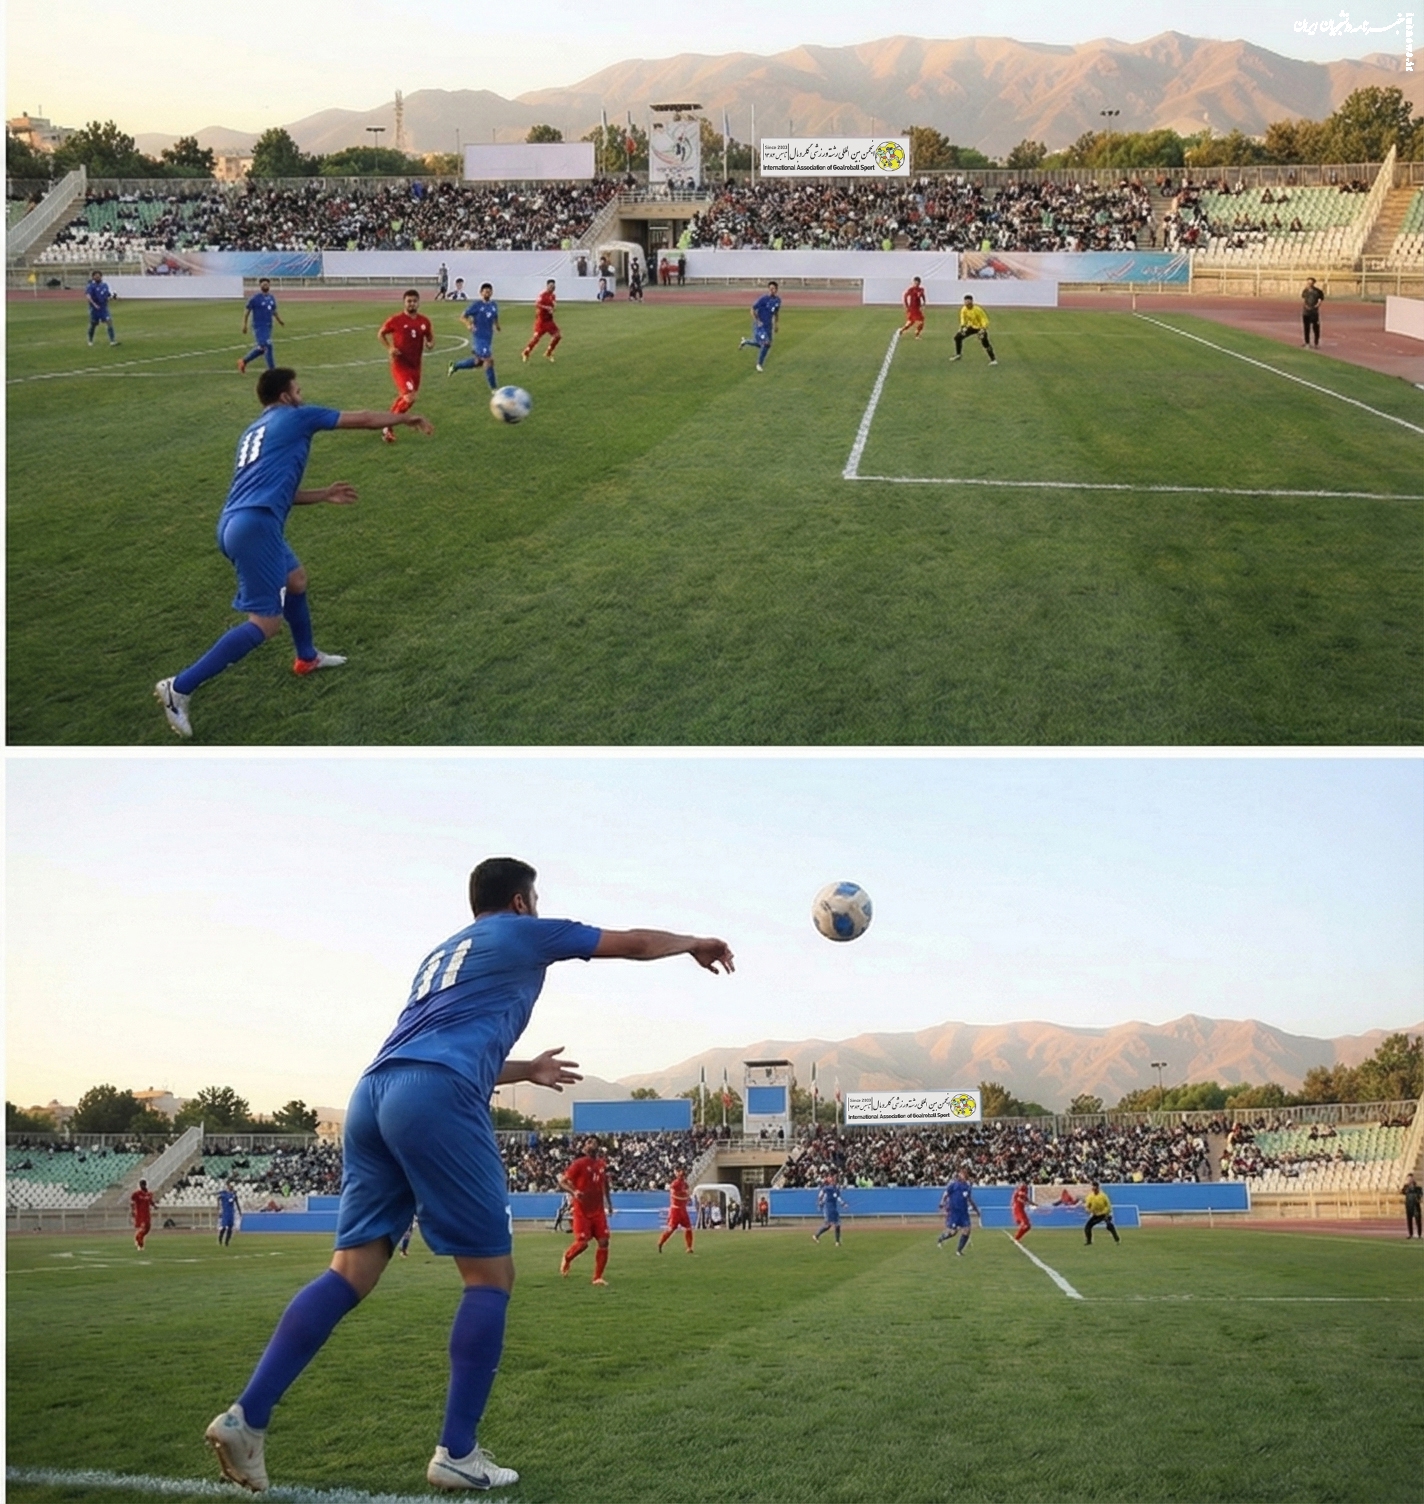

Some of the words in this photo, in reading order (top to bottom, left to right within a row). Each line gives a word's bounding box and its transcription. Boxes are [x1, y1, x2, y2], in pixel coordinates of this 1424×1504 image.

[860, 164, 876, 172] Sport
[237, 425, 266, 468] 11
[416, 938, 473, 1001] 11
